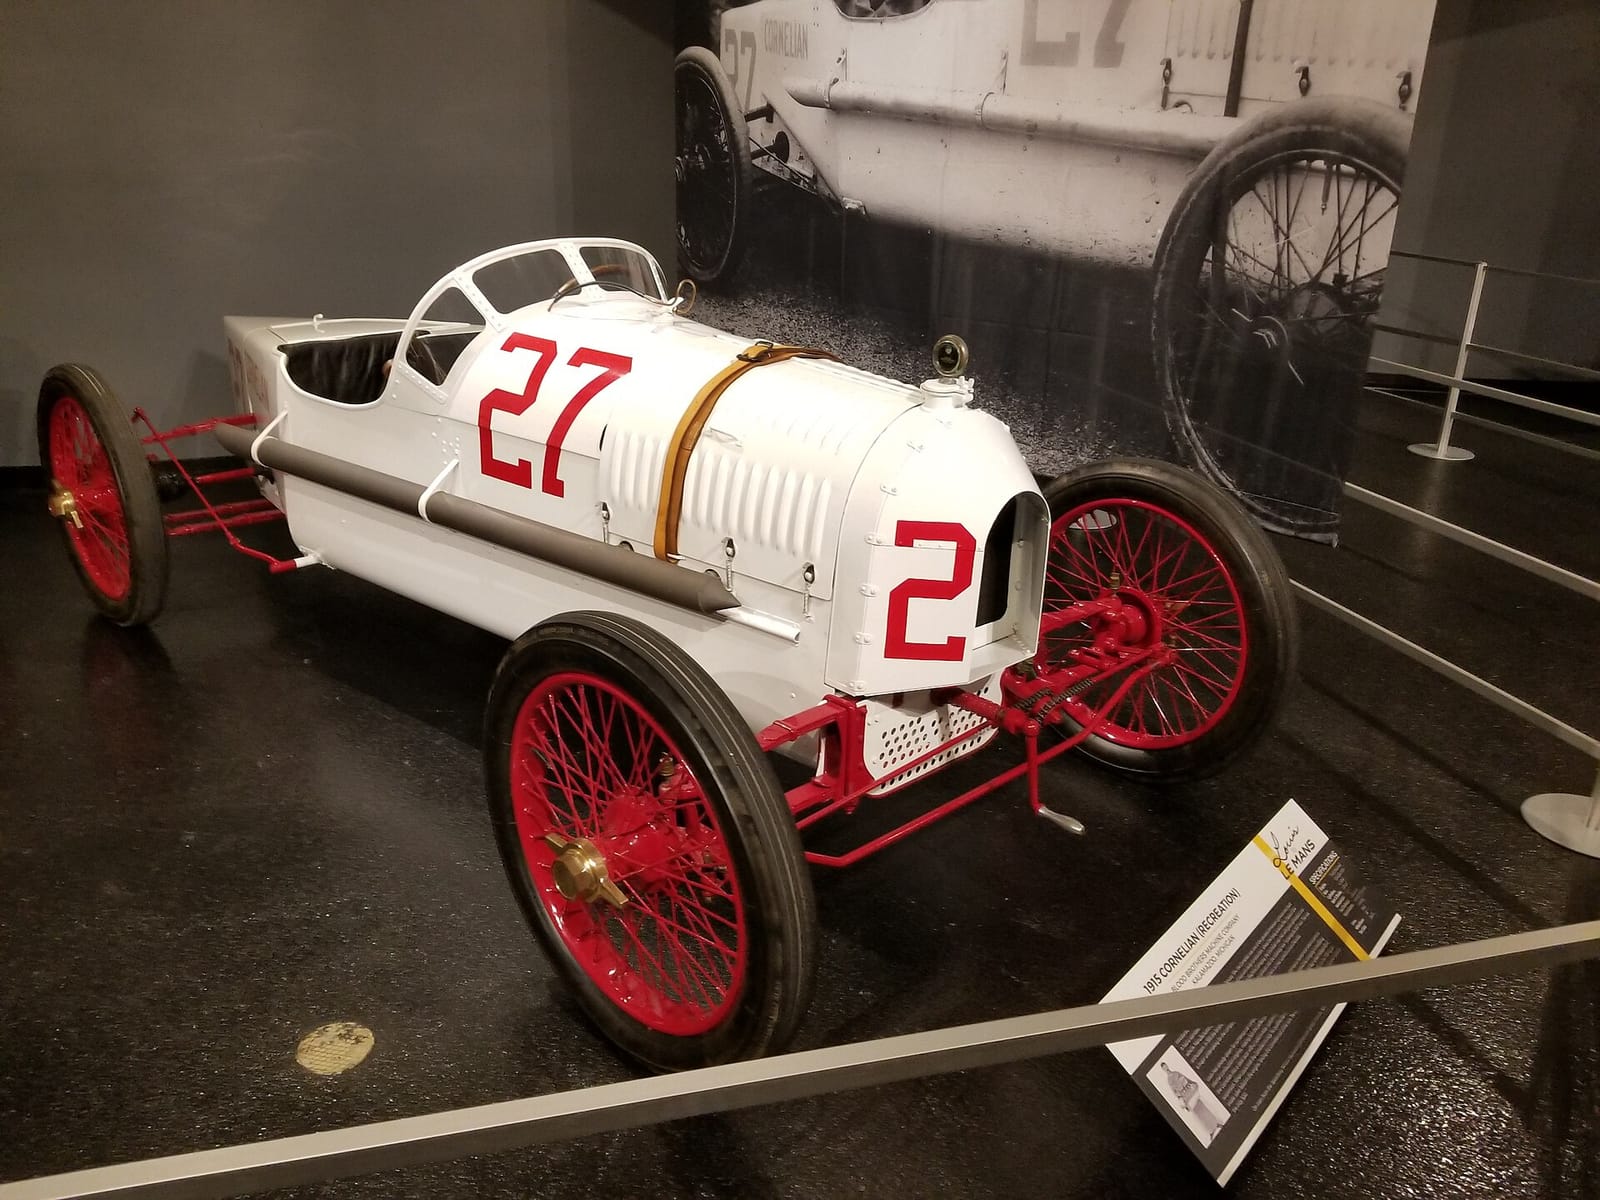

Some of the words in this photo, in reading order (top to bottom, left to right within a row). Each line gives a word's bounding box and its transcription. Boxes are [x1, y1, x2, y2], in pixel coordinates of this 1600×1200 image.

[763, 19, 808, 59] CORNELIAN
[478, 332, 633, 498] 27
[884, 520, 977, 661] 2
[1270, 825, 1299, 868] Louis
[1280, 863, 1294, 880] LE
[1291, 839, 1315, 869] MANS
[1143, 973, 1162, 995] 1915
[1159, 931, 1200, 978] CORNELIAN
[1196, 887, 1241, 938] (RECREATION)
